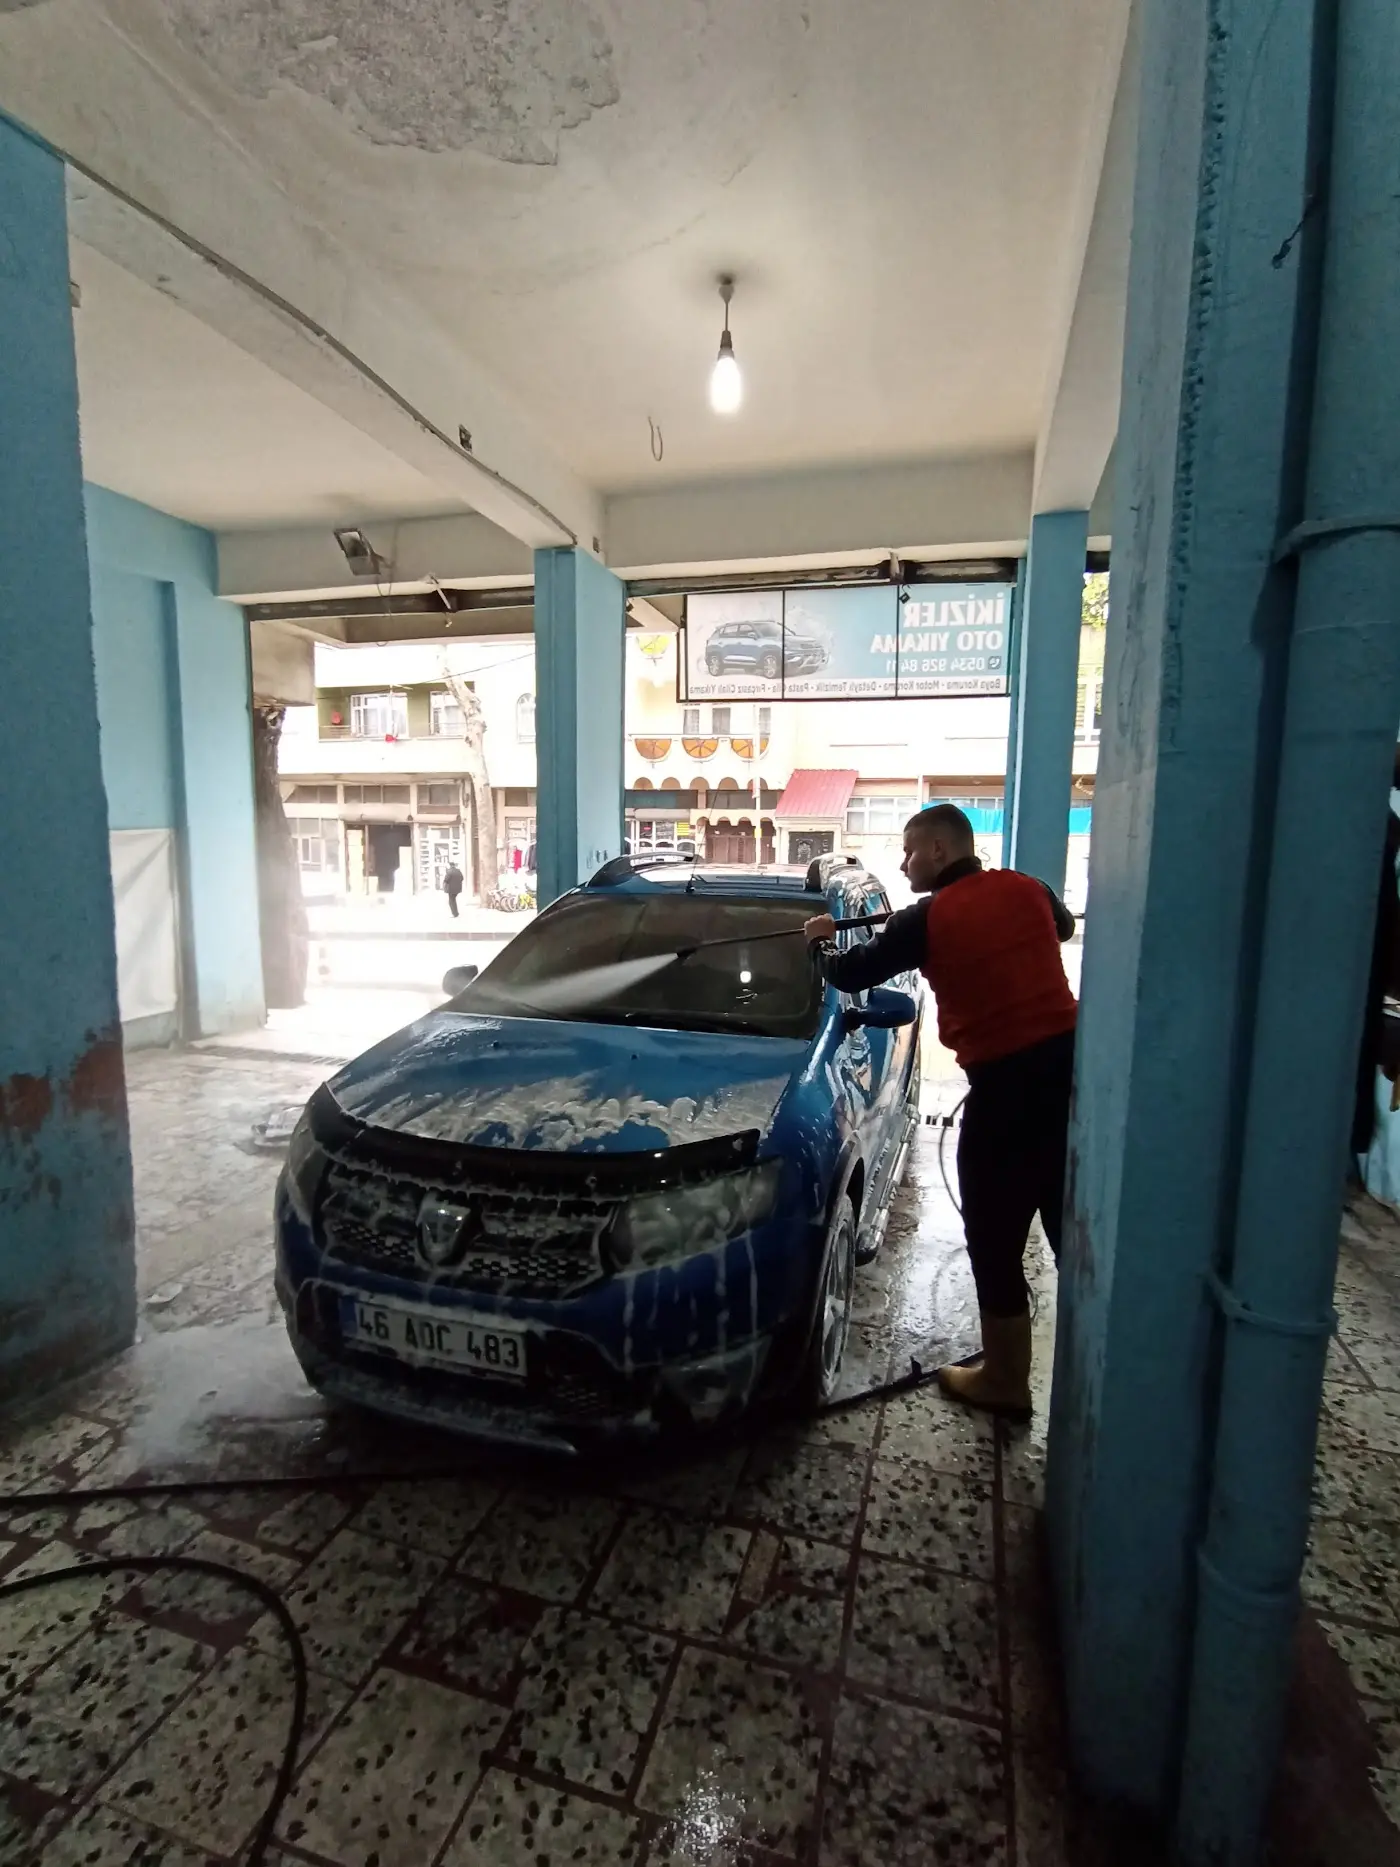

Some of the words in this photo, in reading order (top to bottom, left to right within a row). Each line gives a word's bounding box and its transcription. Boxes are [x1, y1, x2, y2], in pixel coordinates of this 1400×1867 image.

[360, 1308, 389, 1339] 46
[406, 1318, 451, 1355] ADC
[467, 1332, 519, 1368] 483
